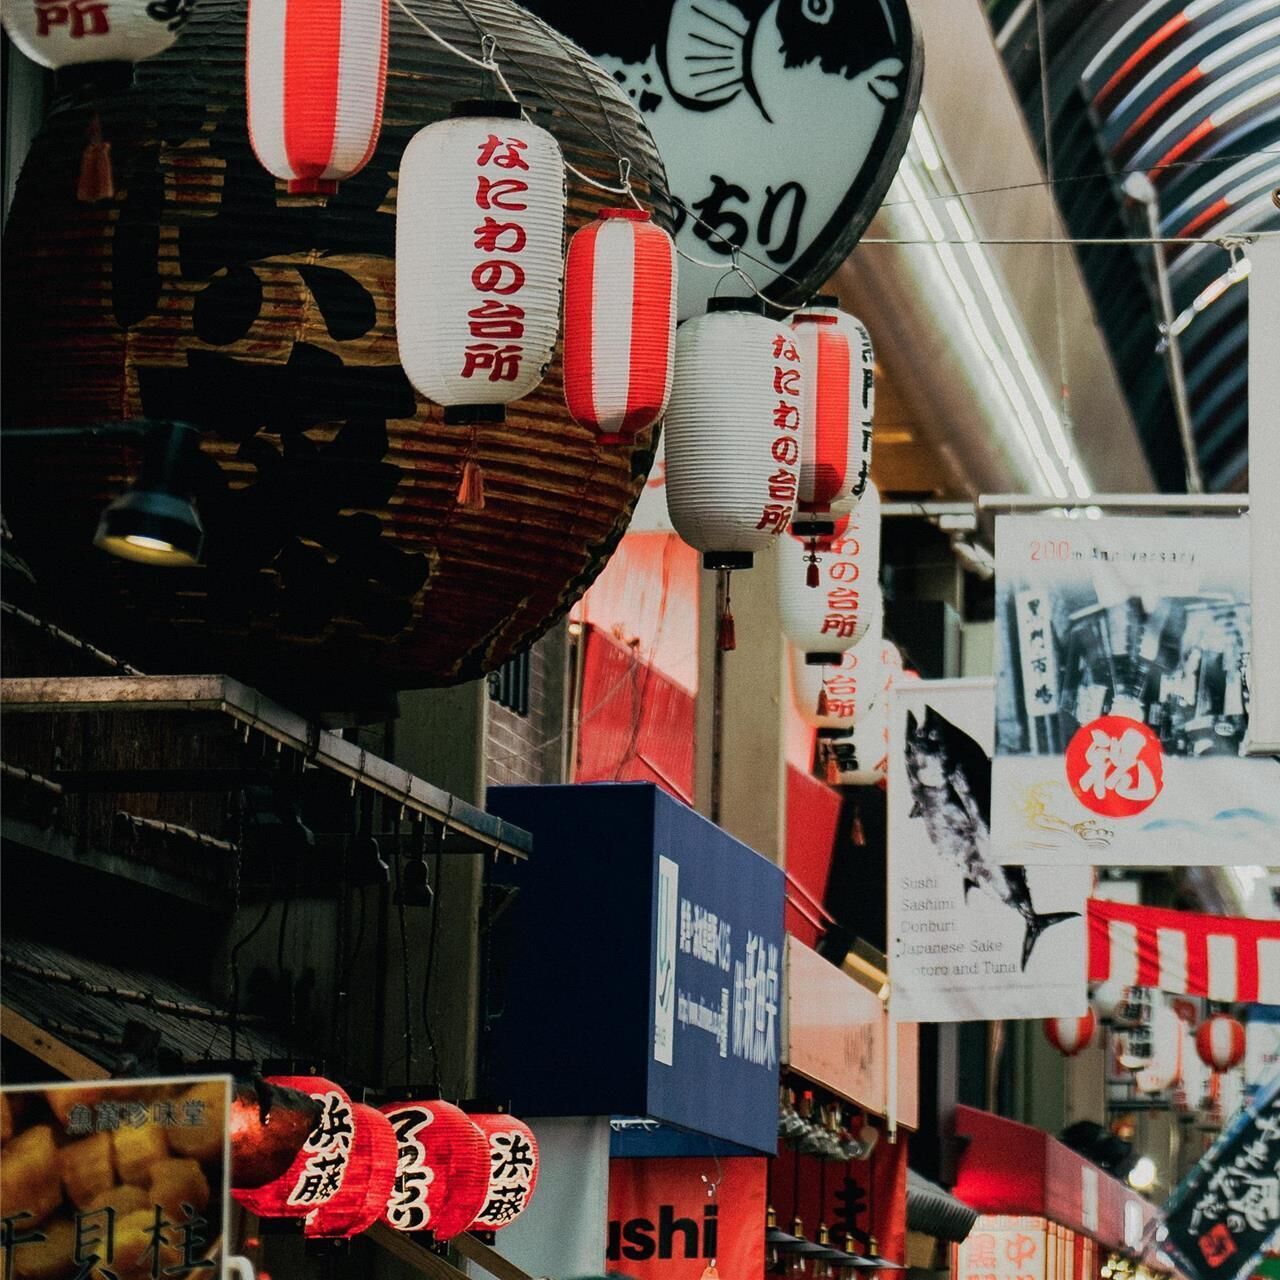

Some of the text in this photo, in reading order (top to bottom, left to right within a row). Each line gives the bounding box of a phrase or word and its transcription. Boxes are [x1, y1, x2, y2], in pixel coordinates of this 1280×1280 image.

[461, 134, 531, 382] なにわの台所
[757, 333, 801, 535] なにわの台所
[1078, 730, 1157, 802] 祝
